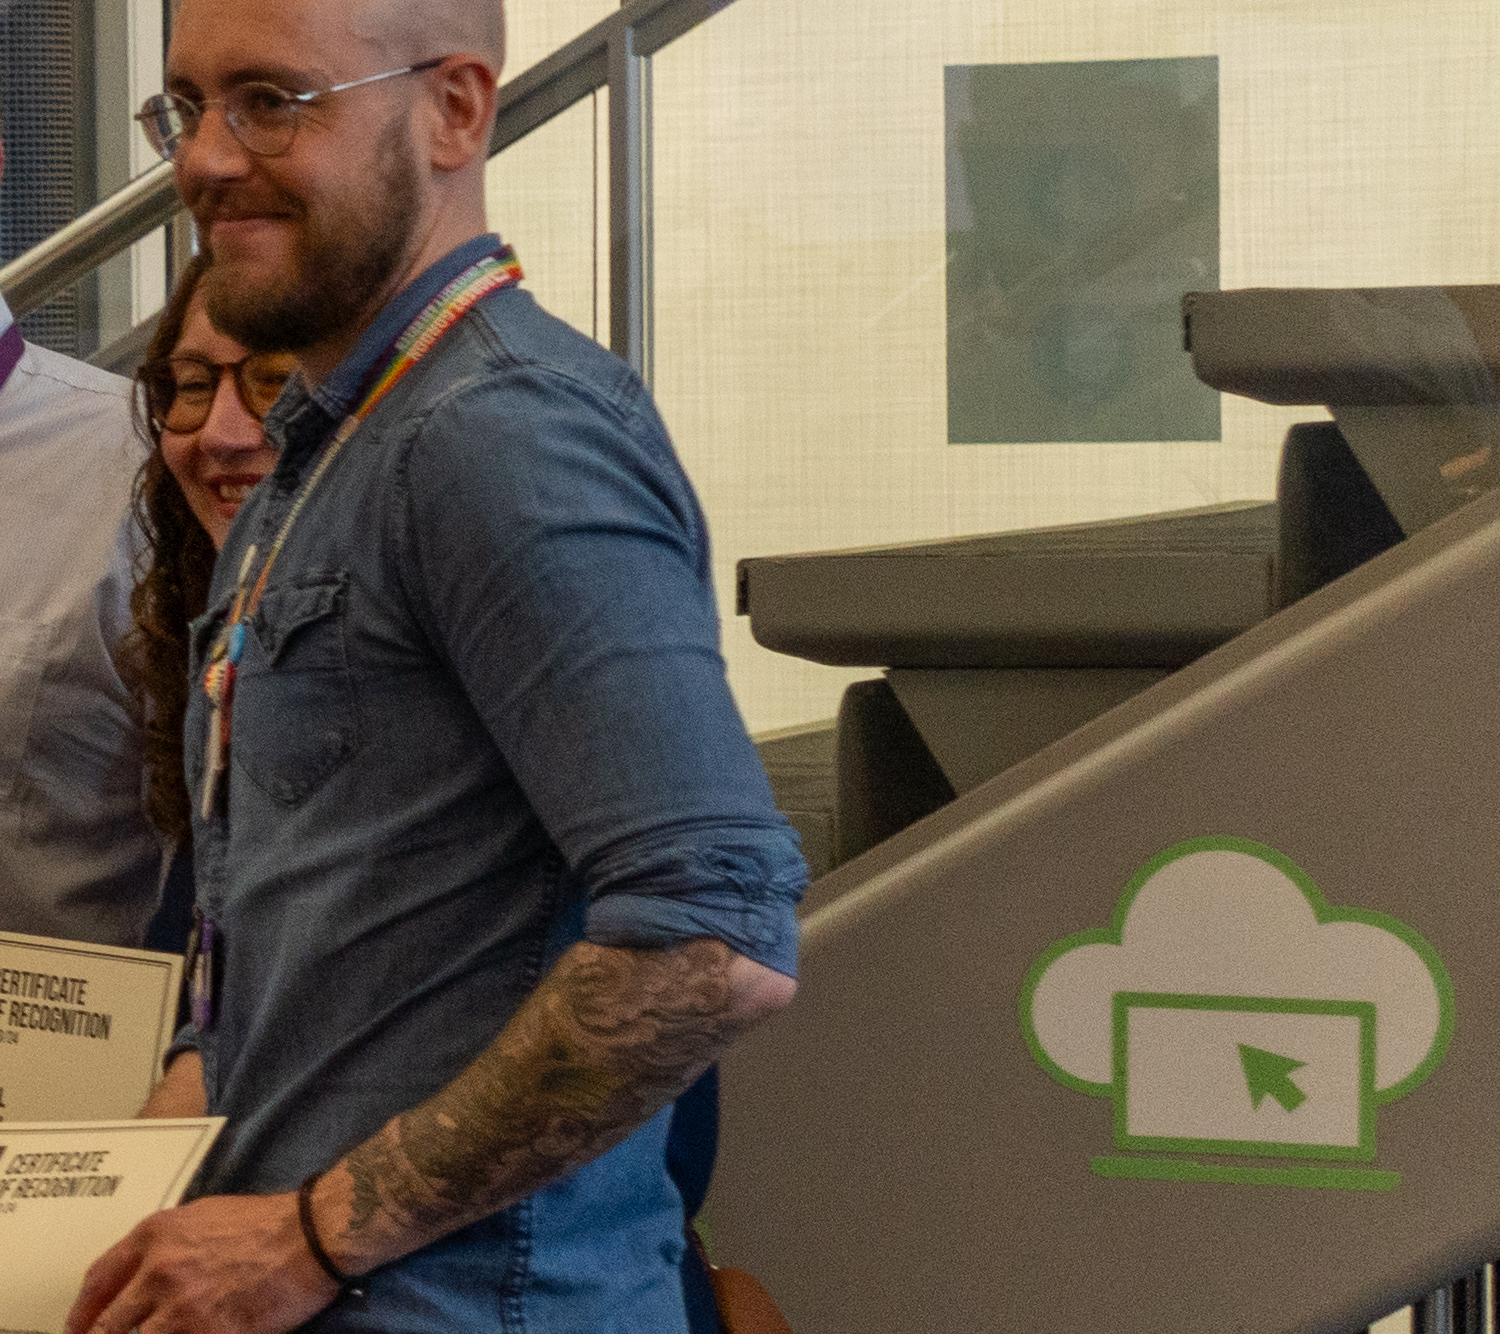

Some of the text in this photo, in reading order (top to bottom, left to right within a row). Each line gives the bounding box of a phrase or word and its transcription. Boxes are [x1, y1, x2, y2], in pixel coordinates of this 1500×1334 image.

[9, 1004, 113, 1040] RECOGNITION
[6, 1151, 106, 1174] CERTIFICATE
[14, 1175, 119, 1198] RECOGNITION
